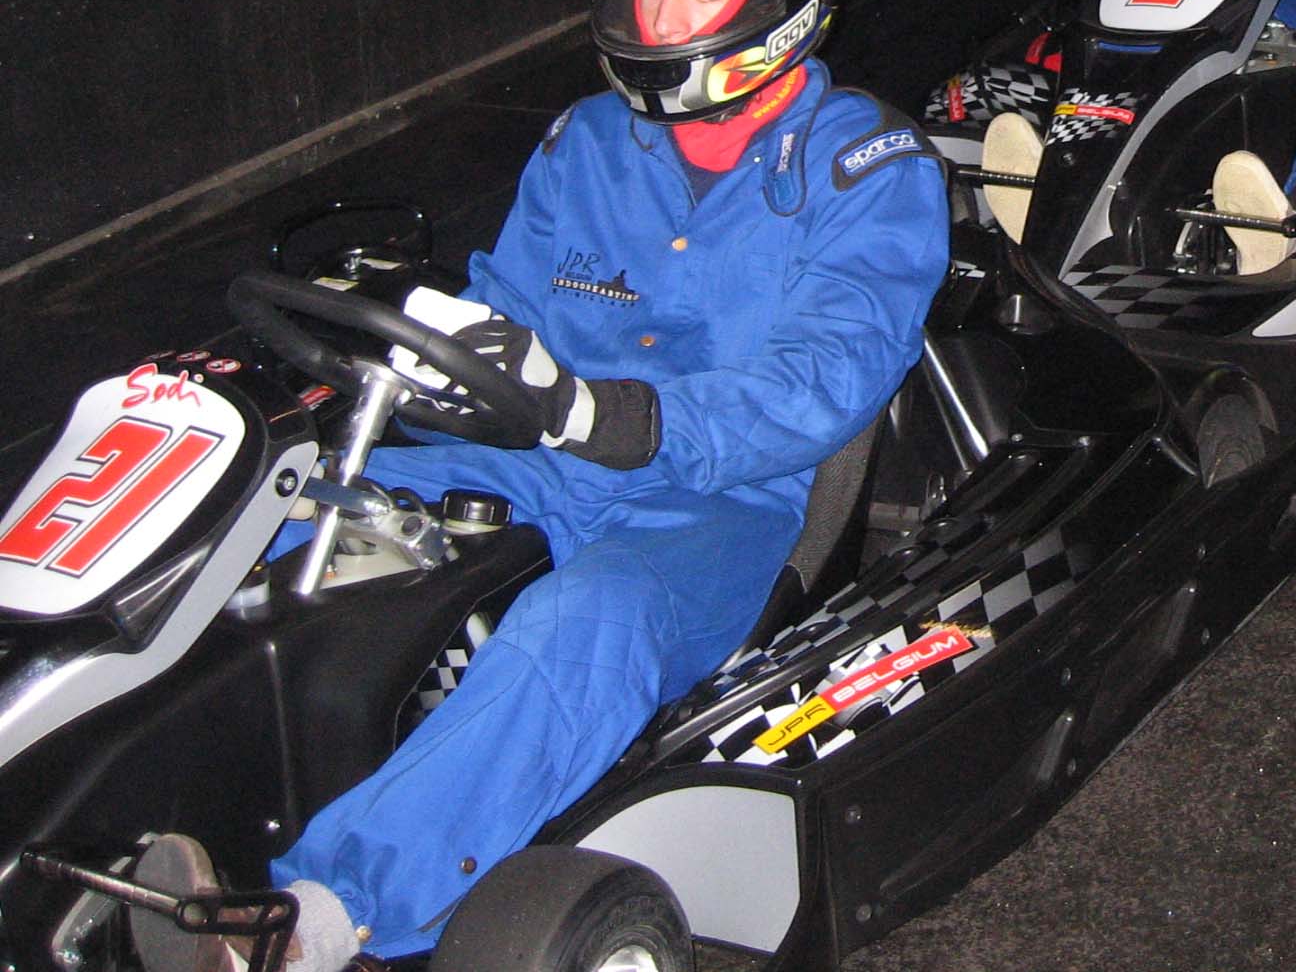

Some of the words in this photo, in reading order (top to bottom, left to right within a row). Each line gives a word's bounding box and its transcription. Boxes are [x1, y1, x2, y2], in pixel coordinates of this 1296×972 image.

[773, 5, 817, 51] agv
[844, 132, 917, 171] sparco
[121, 362, 204, 409] Sodi
[0, 414, 226, 579] 21
[831, 634, 959, 704] BELGIUM
